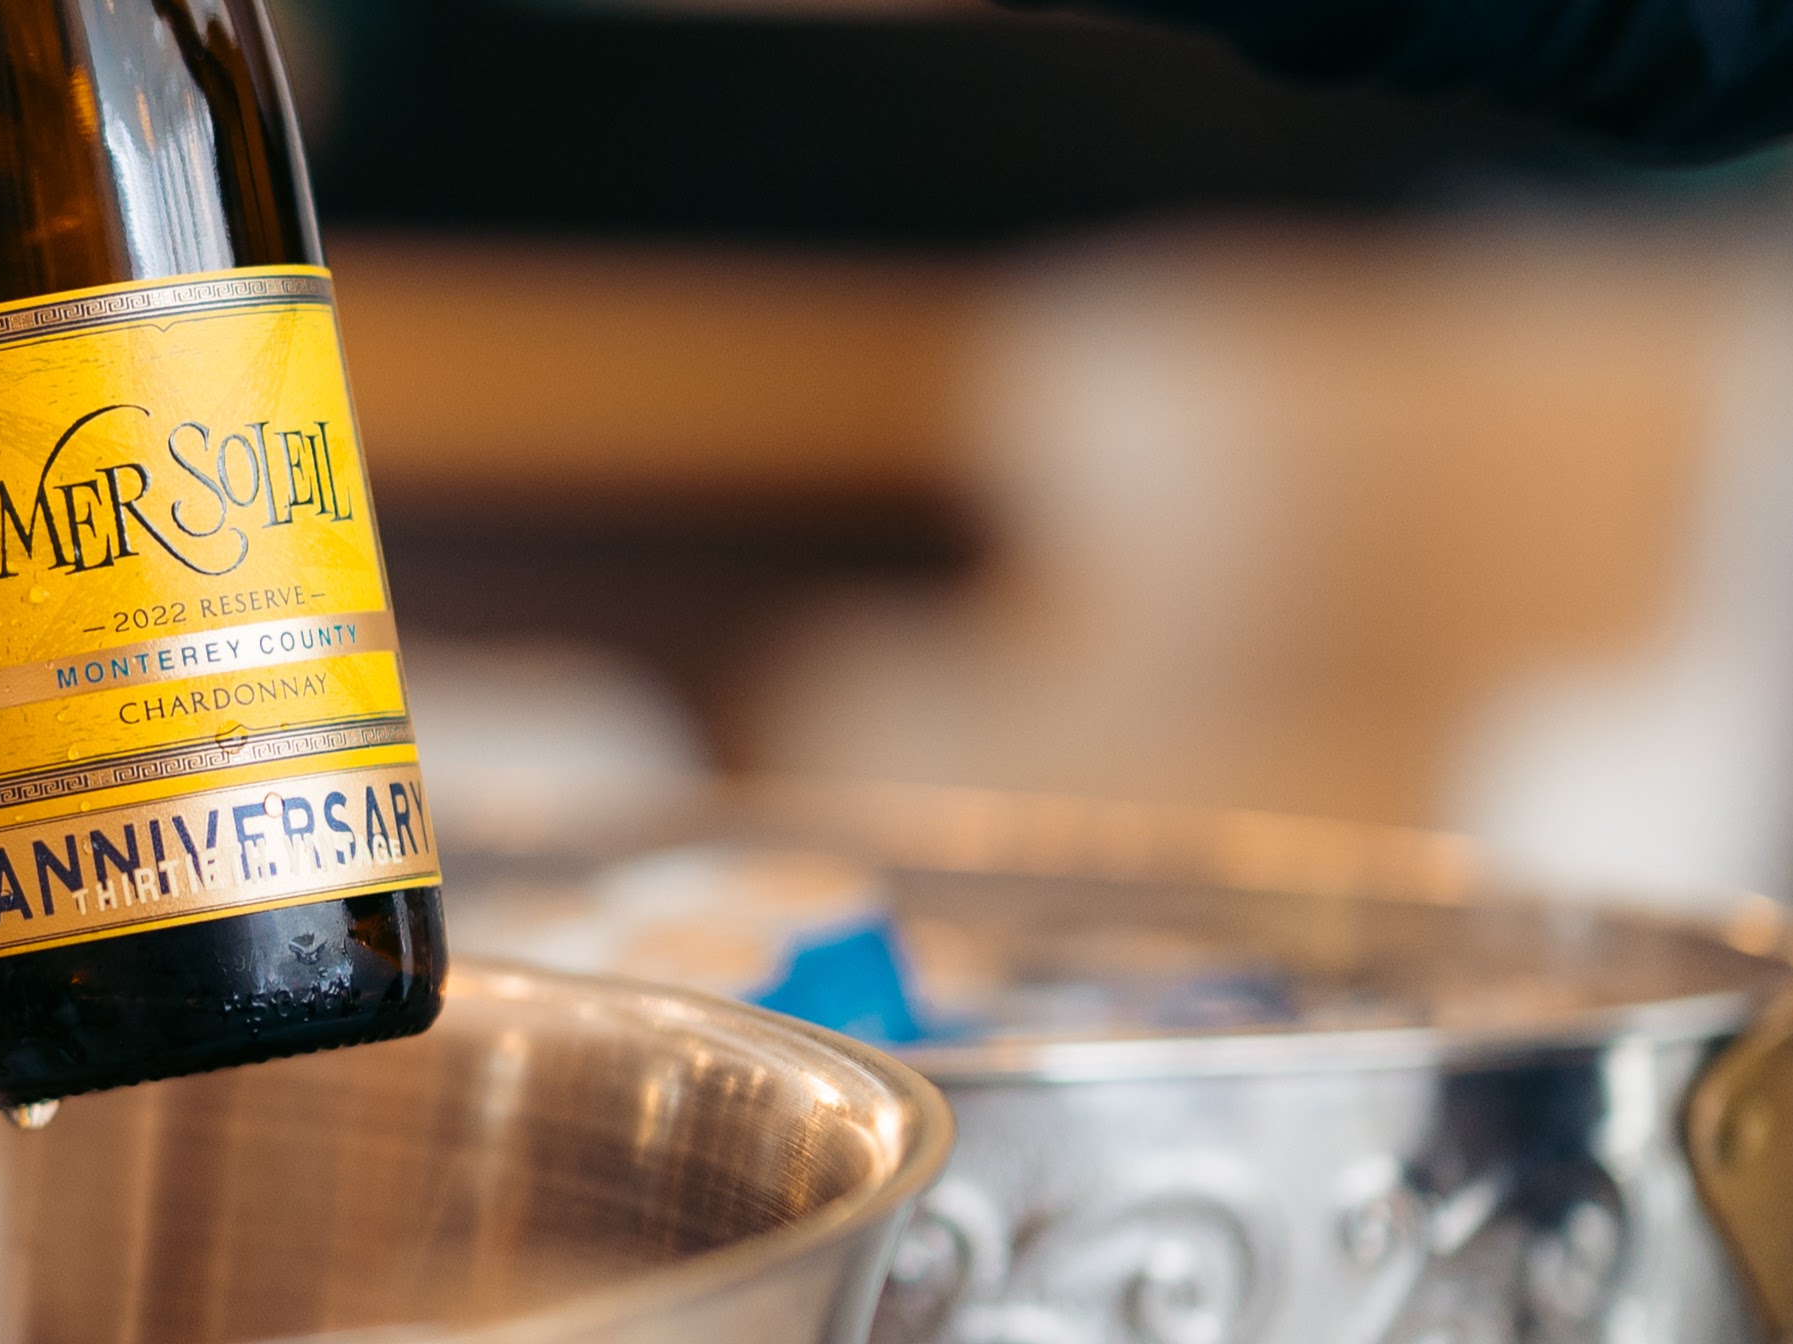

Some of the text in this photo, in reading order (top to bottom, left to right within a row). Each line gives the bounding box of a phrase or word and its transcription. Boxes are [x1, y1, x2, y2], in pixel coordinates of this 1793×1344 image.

[167, 421, 353, 538] SOLEIL
[114, 585, 306, 632] 2022 RESERVE
[56, 623, 358, 690] MONTEREY COUNTY
[118, 672, 328, 725] CHARDONNAY
